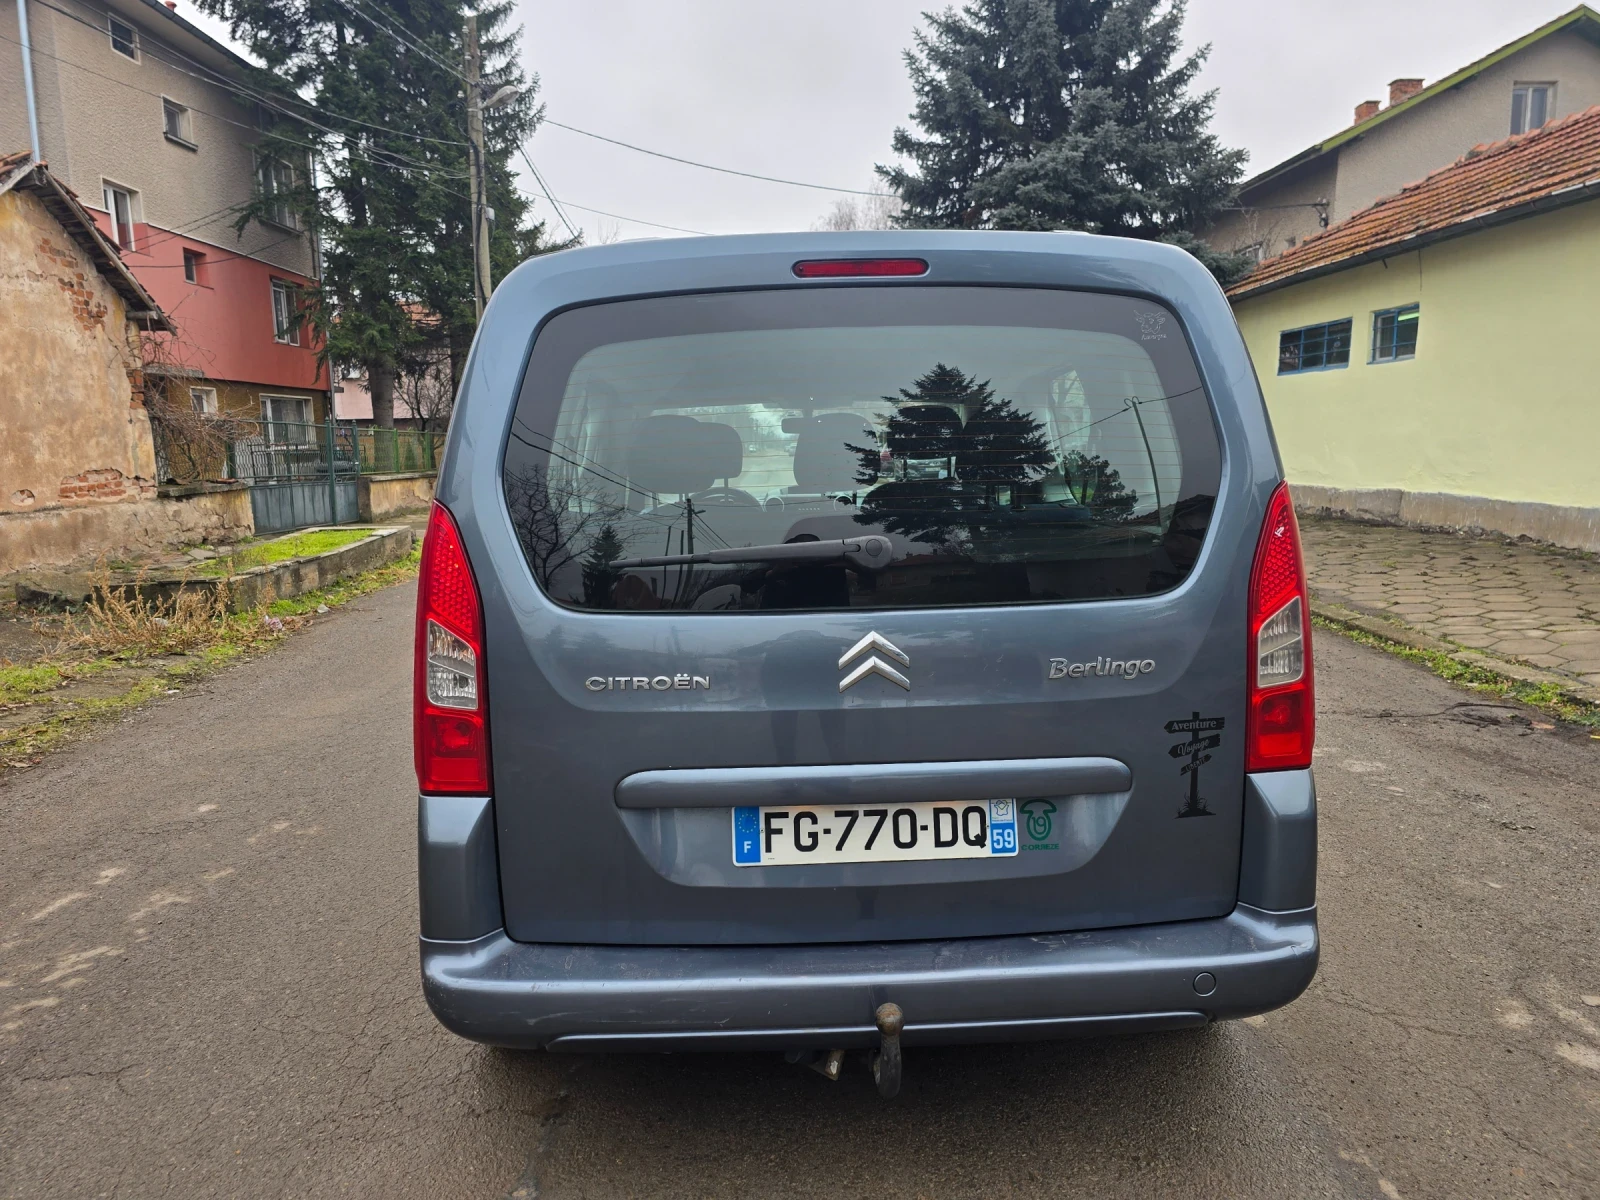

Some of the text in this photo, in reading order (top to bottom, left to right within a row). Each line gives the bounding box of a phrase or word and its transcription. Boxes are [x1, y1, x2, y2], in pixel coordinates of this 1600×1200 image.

[1049, 656, 1155, 680] Berlingo
[585, 673, 710, 691] CITROËN
[1172, 720, 1217, 730] Aventure
[1178, 739, 1209, 755] Voyage
[764, 806, 987, 853] FG-770-DQ
[743, 841, 752, 853] F
[992, 829, 1015, 849] 59
